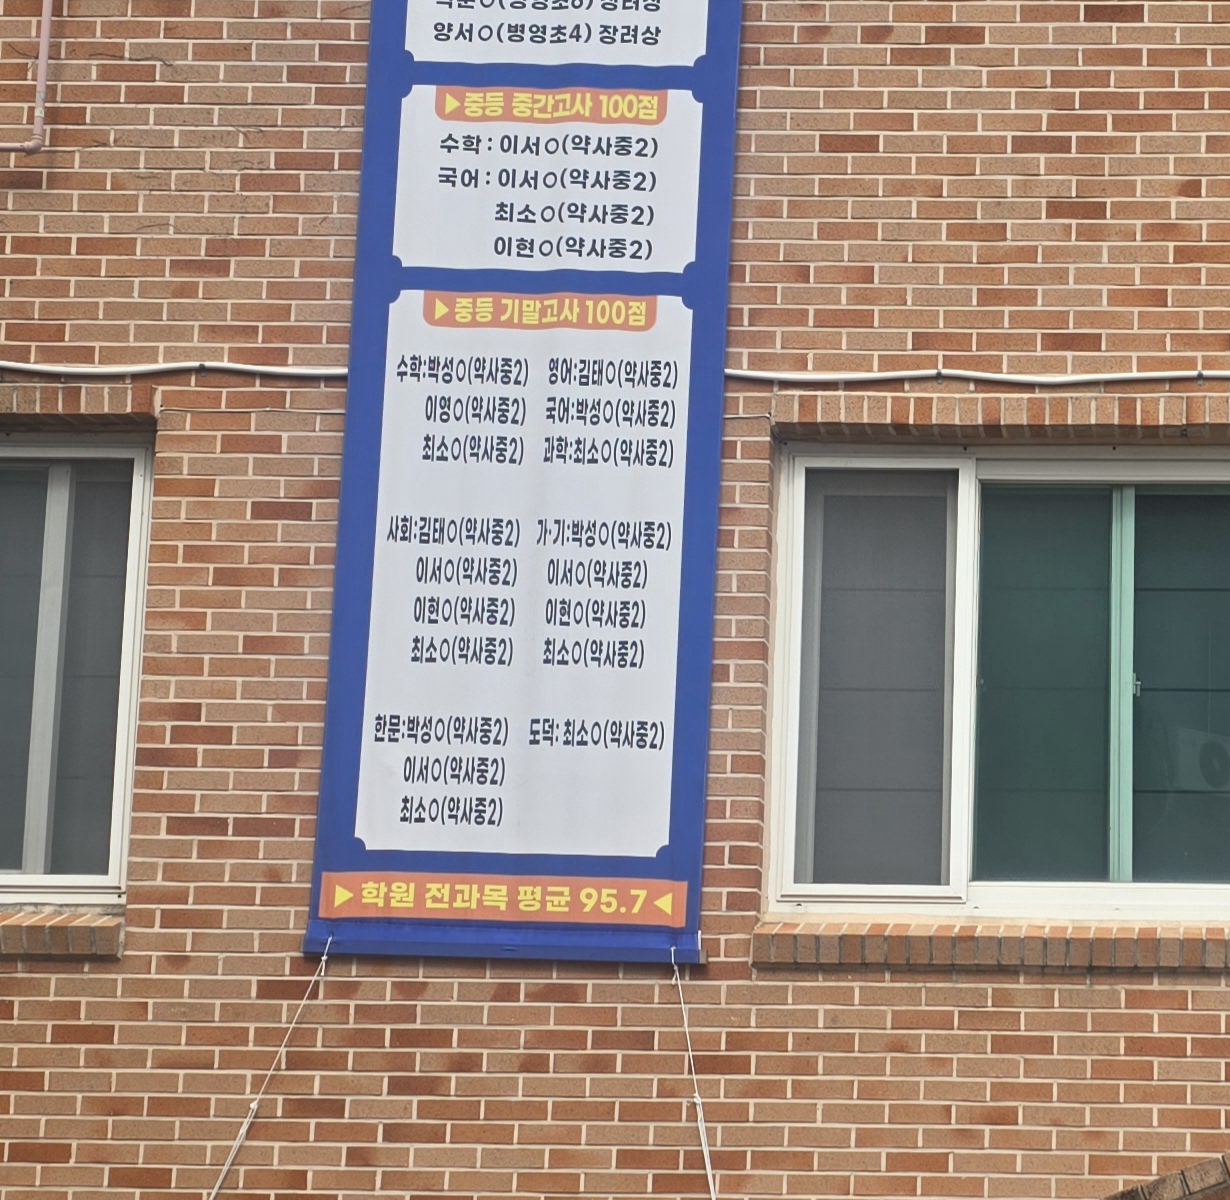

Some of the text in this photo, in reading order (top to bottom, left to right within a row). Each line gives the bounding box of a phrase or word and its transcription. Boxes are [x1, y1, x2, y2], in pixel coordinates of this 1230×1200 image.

[599, 25, 661, 45] 장려상
[464, 93, 658, 119] 중등 중간고사 100점
[455, 298, 646, 325] 중등 기말고사 100점
[362, 882, 647, 913] 학원 전과목 평균 95.7
